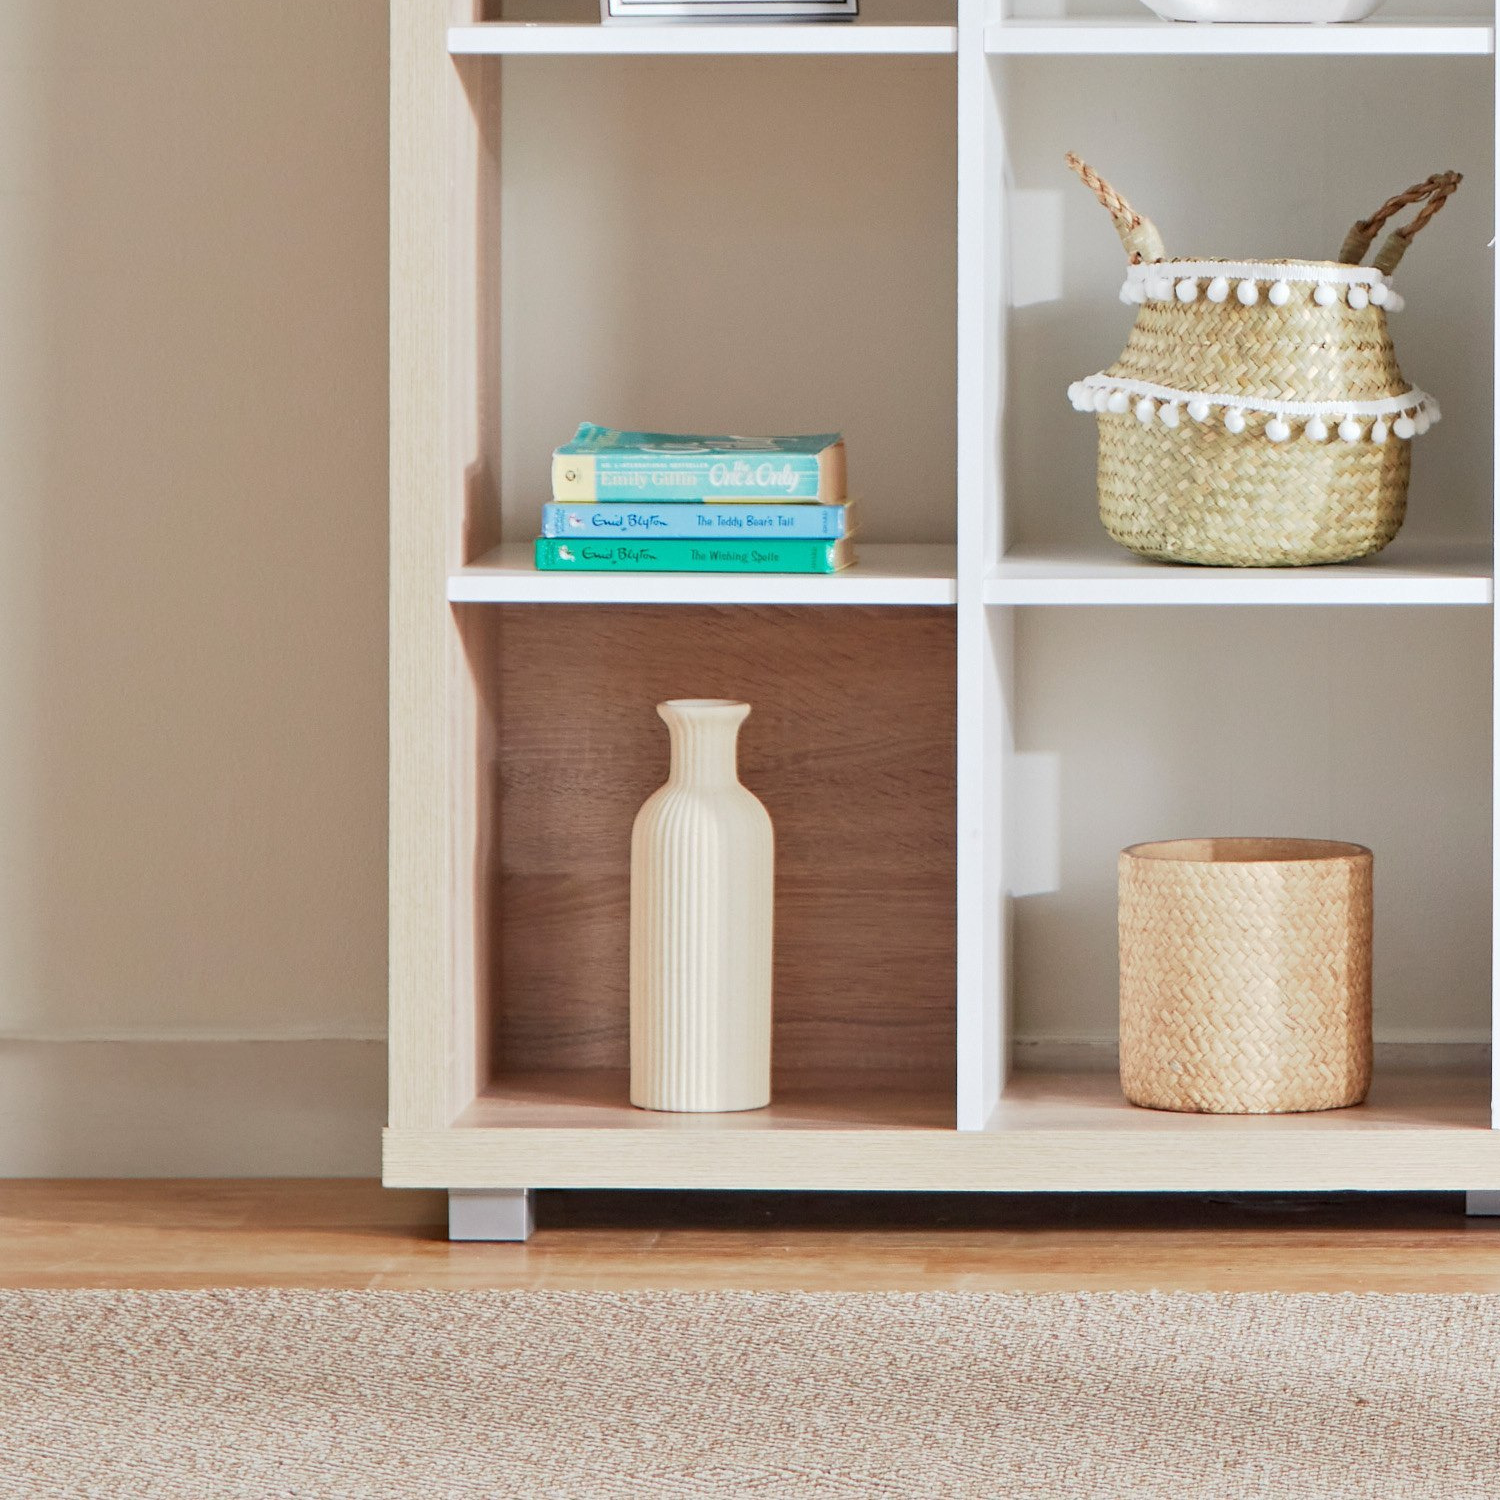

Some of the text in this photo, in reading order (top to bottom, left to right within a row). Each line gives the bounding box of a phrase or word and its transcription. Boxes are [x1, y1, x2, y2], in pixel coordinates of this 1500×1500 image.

[756, 461, 799, 493] Only
[591, 513, 668, 529] Enid Blyton
[697, 514, 794, 528] The Teddy Bear's Tail
[581, 546, 657, 564] Enid Blyton
[691, 549, 706, 561] The
[709, 550, 749, 564] Wishing
